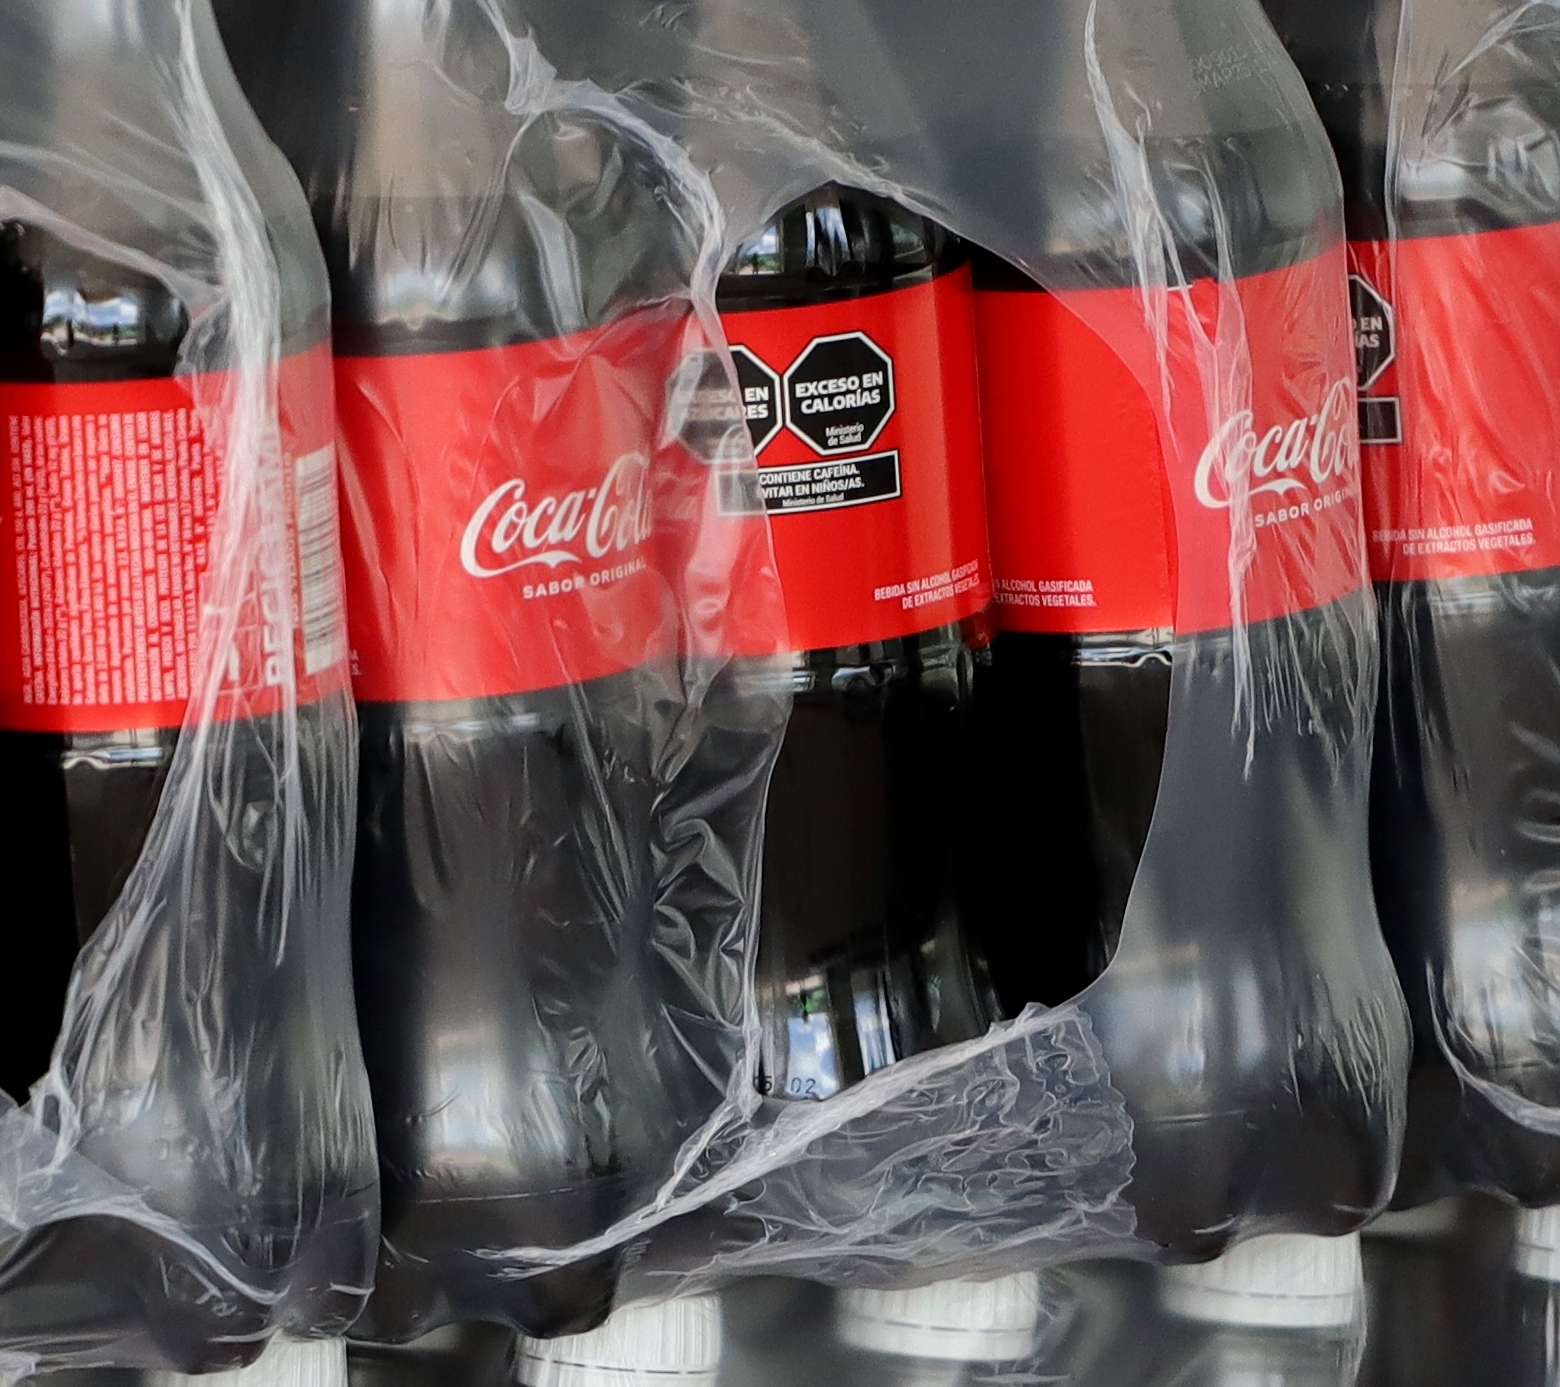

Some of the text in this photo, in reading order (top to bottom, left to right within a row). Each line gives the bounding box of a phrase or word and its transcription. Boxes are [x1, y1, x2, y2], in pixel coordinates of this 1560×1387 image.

[745, 386, 769, 402] EN
[795, 371, 883, 398] EXCESO EN
[801, 389, 881, 415] CALORÍAS
[759, 463, 860, 485] CONTIENE CAFEÍNA.
[795, 476, 865, 497] EN NIÑOS/AS.
[1255, 502, 1309, 527] SABOR
[1427, 525, 1472, 539] ALCOHOL
[1474, 517, 1533, 535] GASIFICADA
[522, 576, 585, 600] SABOR
[874, 571, 952, 601] BEBIDA SIN ALCOHOL
[1039, 579, 1093, 593] GASIFICADA
[1042, 594, 1097, 608] VEGETALES.
